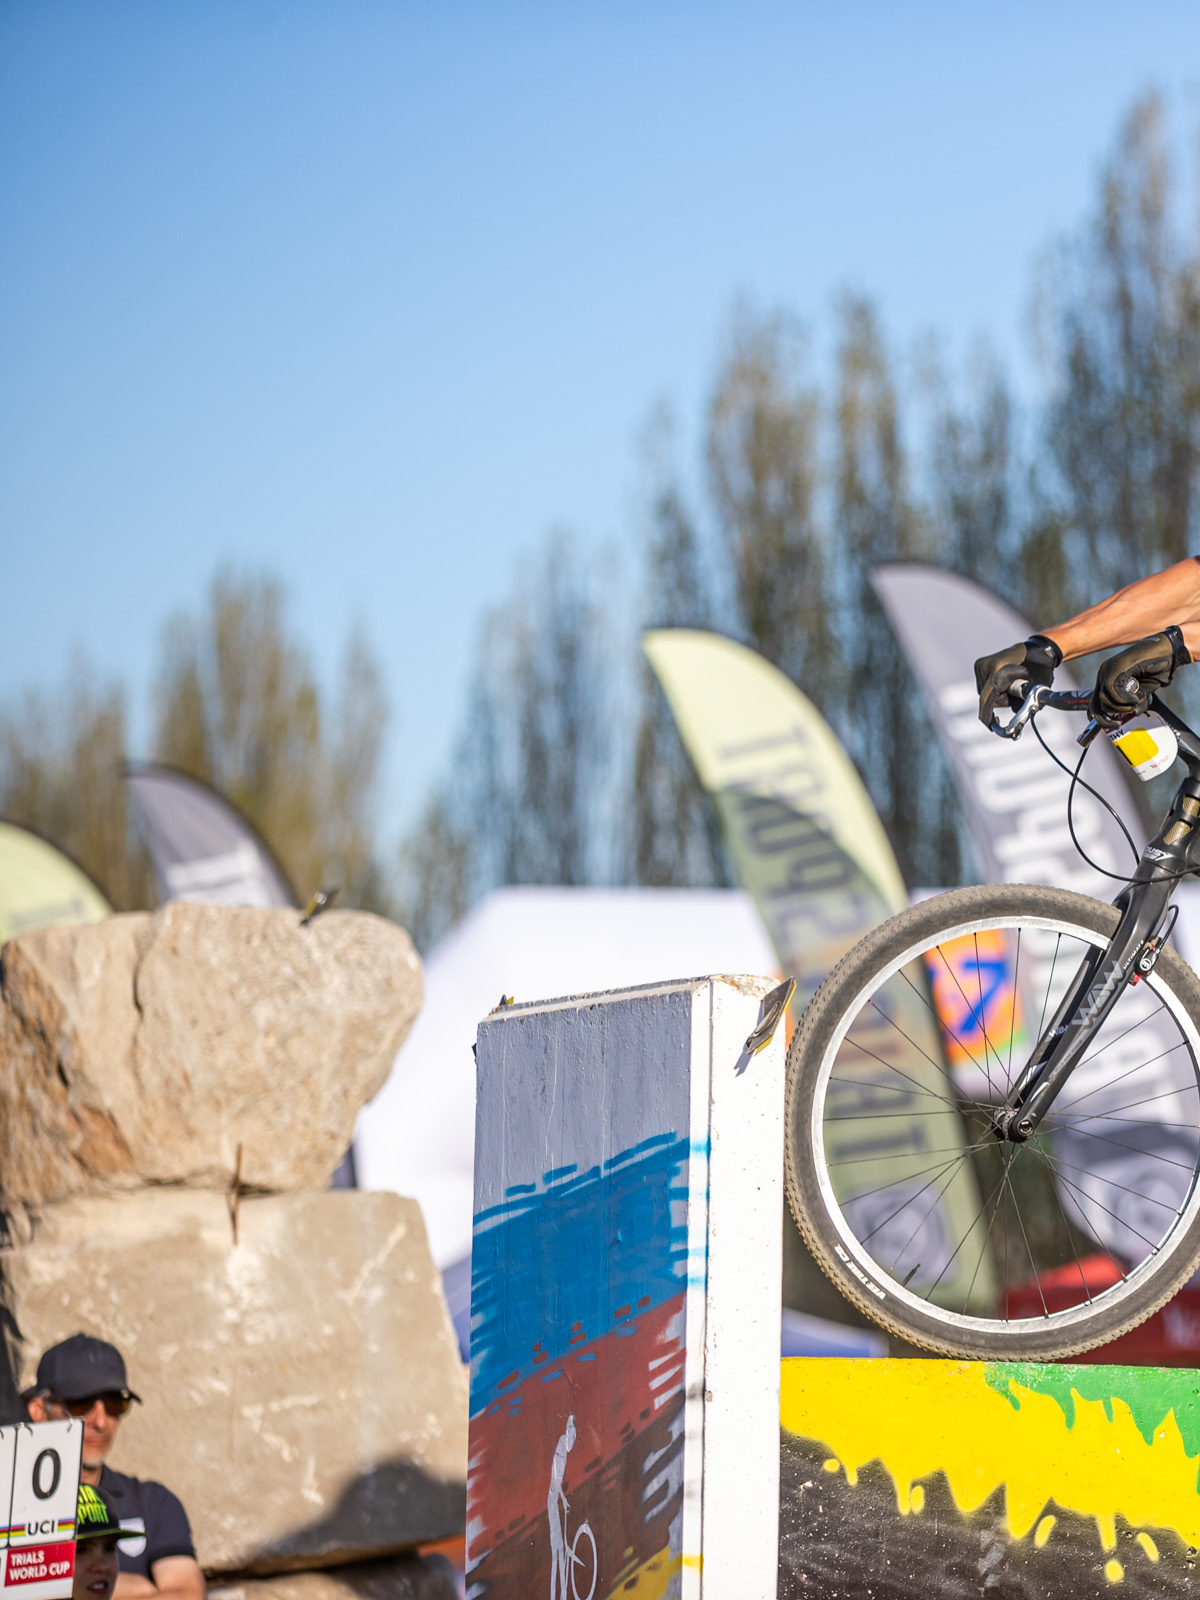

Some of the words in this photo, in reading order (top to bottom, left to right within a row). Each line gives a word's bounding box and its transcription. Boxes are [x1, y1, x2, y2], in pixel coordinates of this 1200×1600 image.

[1109, 728, 1125, 742] THY
[1122, 939, 1145, 970] ULTIMATE
[31, 1447, 62, 1500] 0
[77, 1503, 109, 1525] PORT
[27, 1520, 56, 1536] UCI
[10, 1550, 45, 1568] TRIALS
[9, 1565, 48, 1581] WORLD
[49, 1561, 71, 1577] CUP
